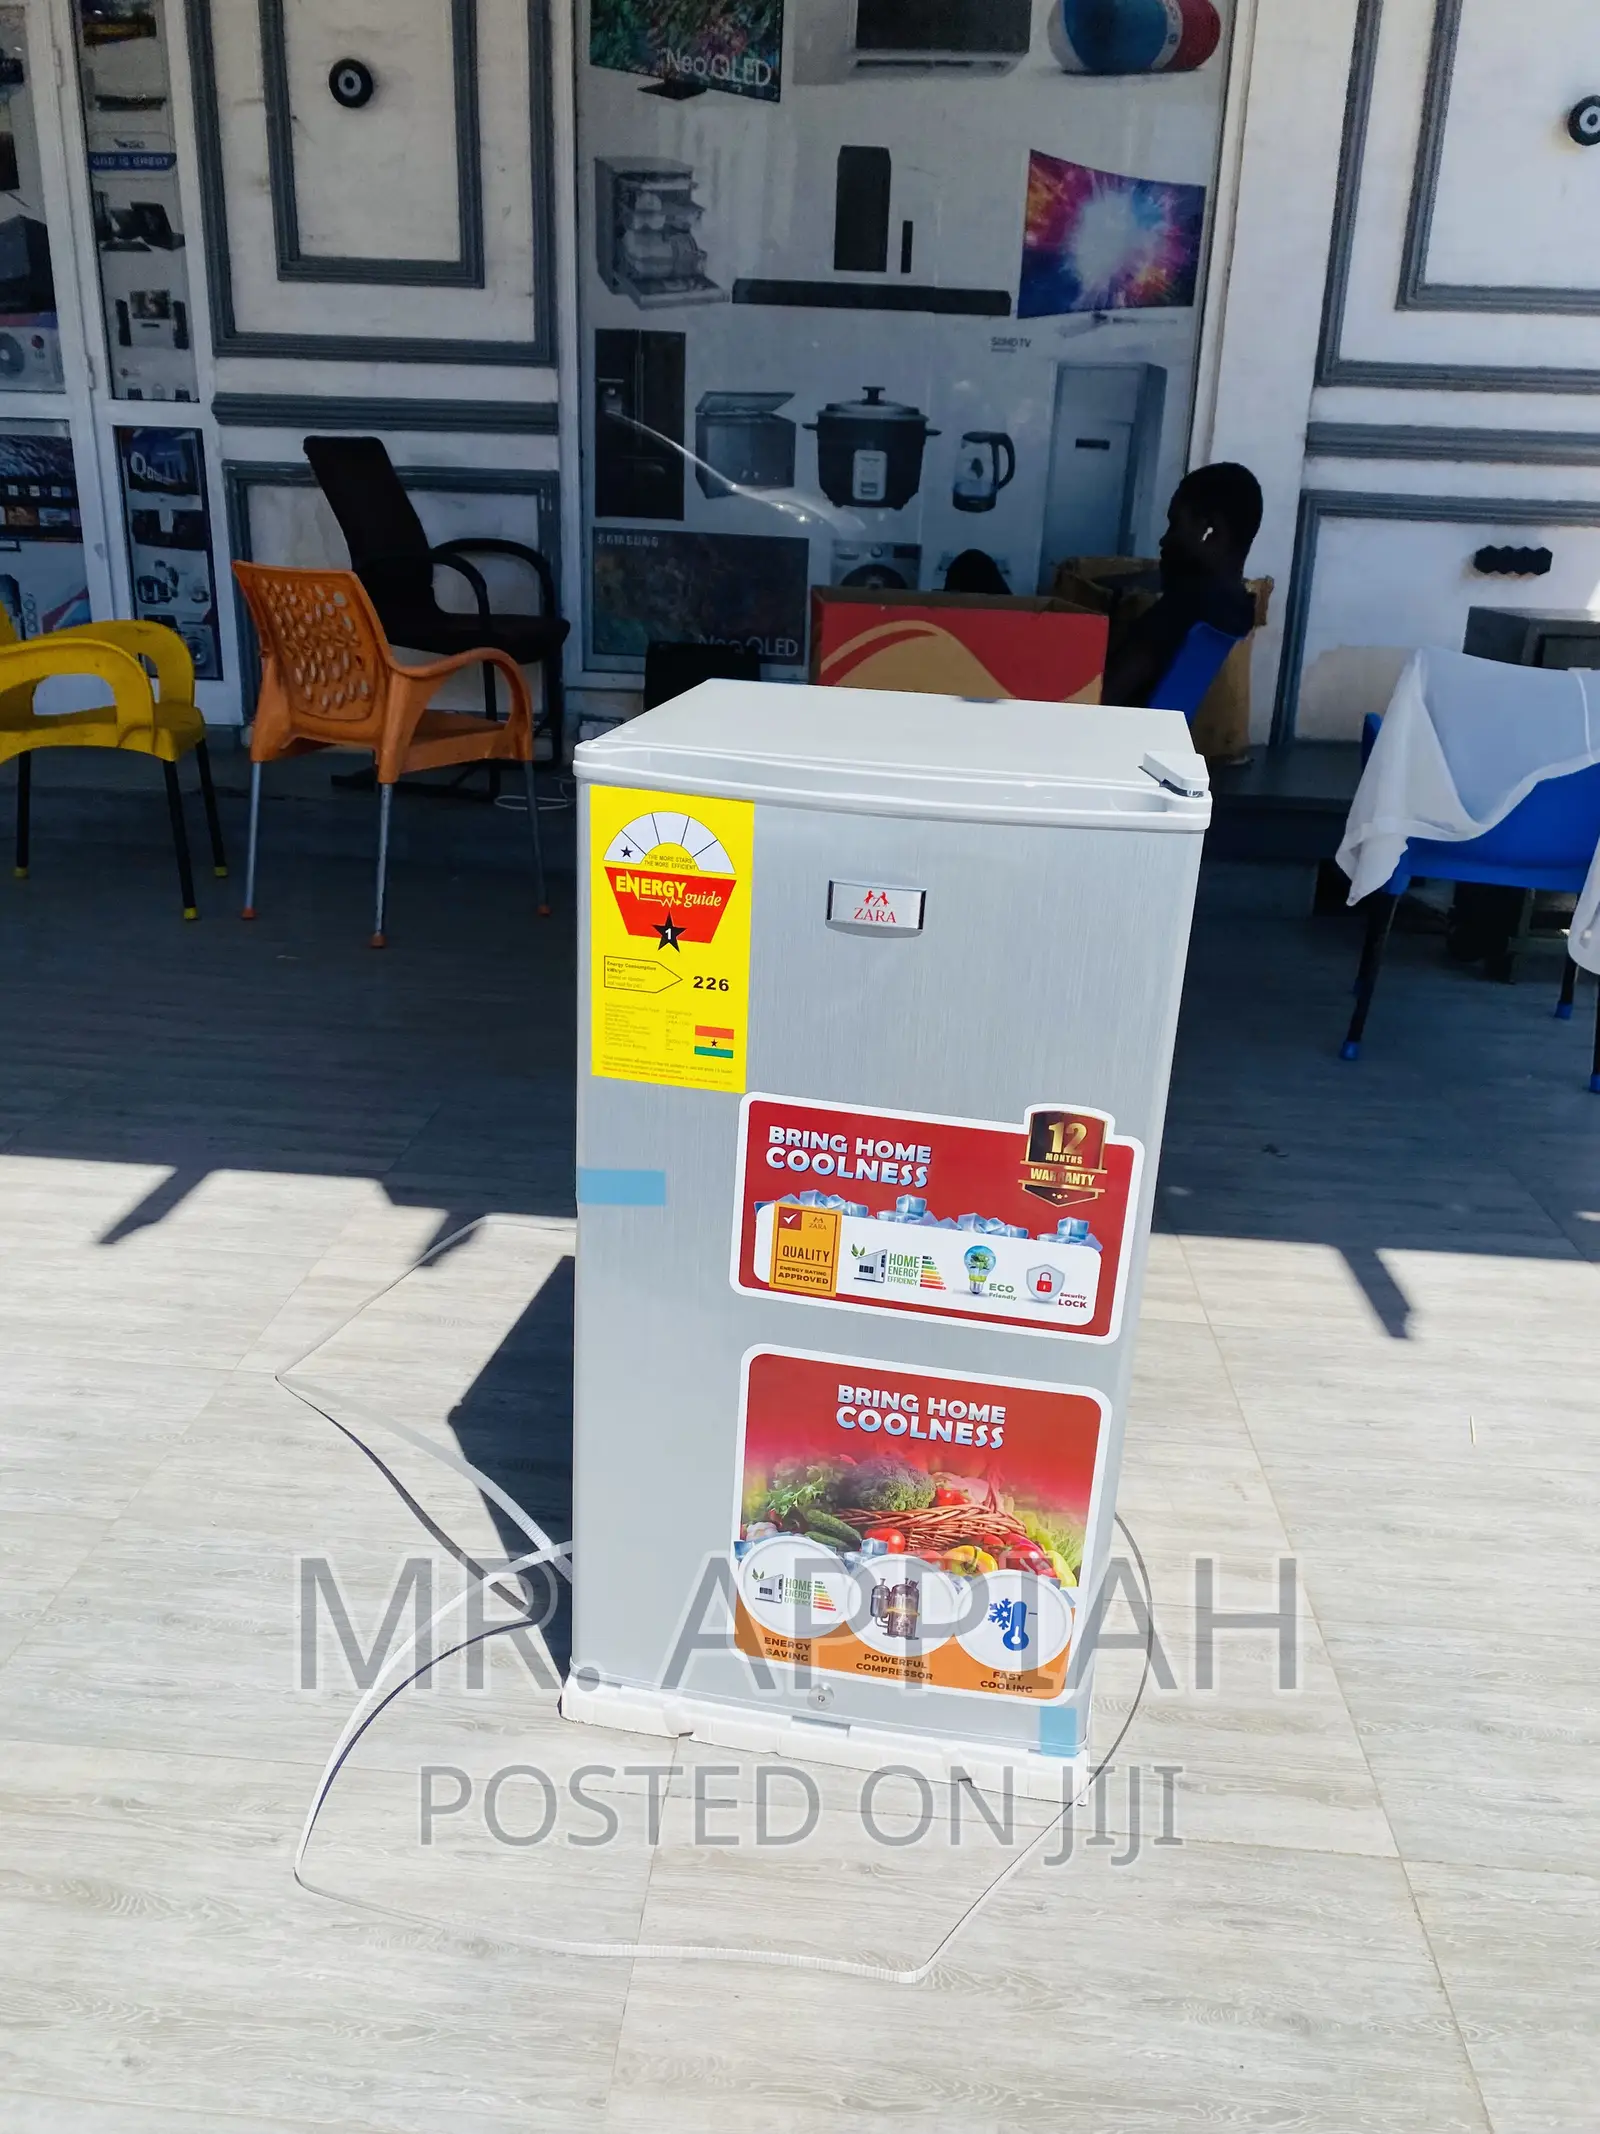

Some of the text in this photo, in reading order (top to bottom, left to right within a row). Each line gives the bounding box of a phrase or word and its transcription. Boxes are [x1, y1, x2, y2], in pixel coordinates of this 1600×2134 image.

[666, 48, 771, 87] Neo QLED
[597, 532, 659, 548] SAMSUNG
[746, 635, 799, 658] QLED
[615, 871, 722, 908] ENERGY guide
[853, 907, 897, 924] ZARA
[665, 928, 672, 940] 1
[693, 975, 730, 992] 226
[768, 1125, 932, 1165] BRING HOME
[1048, 1121, 1088, 1155] 12
[1045, 1152, 1083, 1165] MONTHS
[765, 1147, 929, 1188] COOLNESS
[1030, 1168, 1096, 1186] WARRANTY
[809, 1223, 827, 1231] ZARA
[782, 1245, 831, 1263] QUALITY
[889, 1253, 921, 1268] HOME
[779, 1265, 804, 1273] ENERGY
[888, 1266, 919, 1278] ENERGY
[778, 1271, 829, 1285] APPROVED
[887, 1276, 918, 1286] EFFICIENCY
[988, 1282, 1015, 1293] ECO
[988, 1292, 1018, 1301] Friendly
[1058, 1298, 1088, 1309] LOCK
[1059, 1292, 1087, 1301] Security
[837, 1384, 1007, 1425] BRING HOME
[835, 1405, 1005, 1450] COOLNESS
[785, 1577, 813, 1592] HOME
[784, 1588, 812, 1600] ENERGY
[764, 1637, 811, 1651] ENERGY
[764, 1648, 810, 1662] SAVING
[864, 1653, 928, 1670] POWERFUL
[855, 1662, 934, 1681] COMPRESSOR
[992, 1671, 1025, 1682] FAST
[980, 1680, 1034, 1694] COOLING
